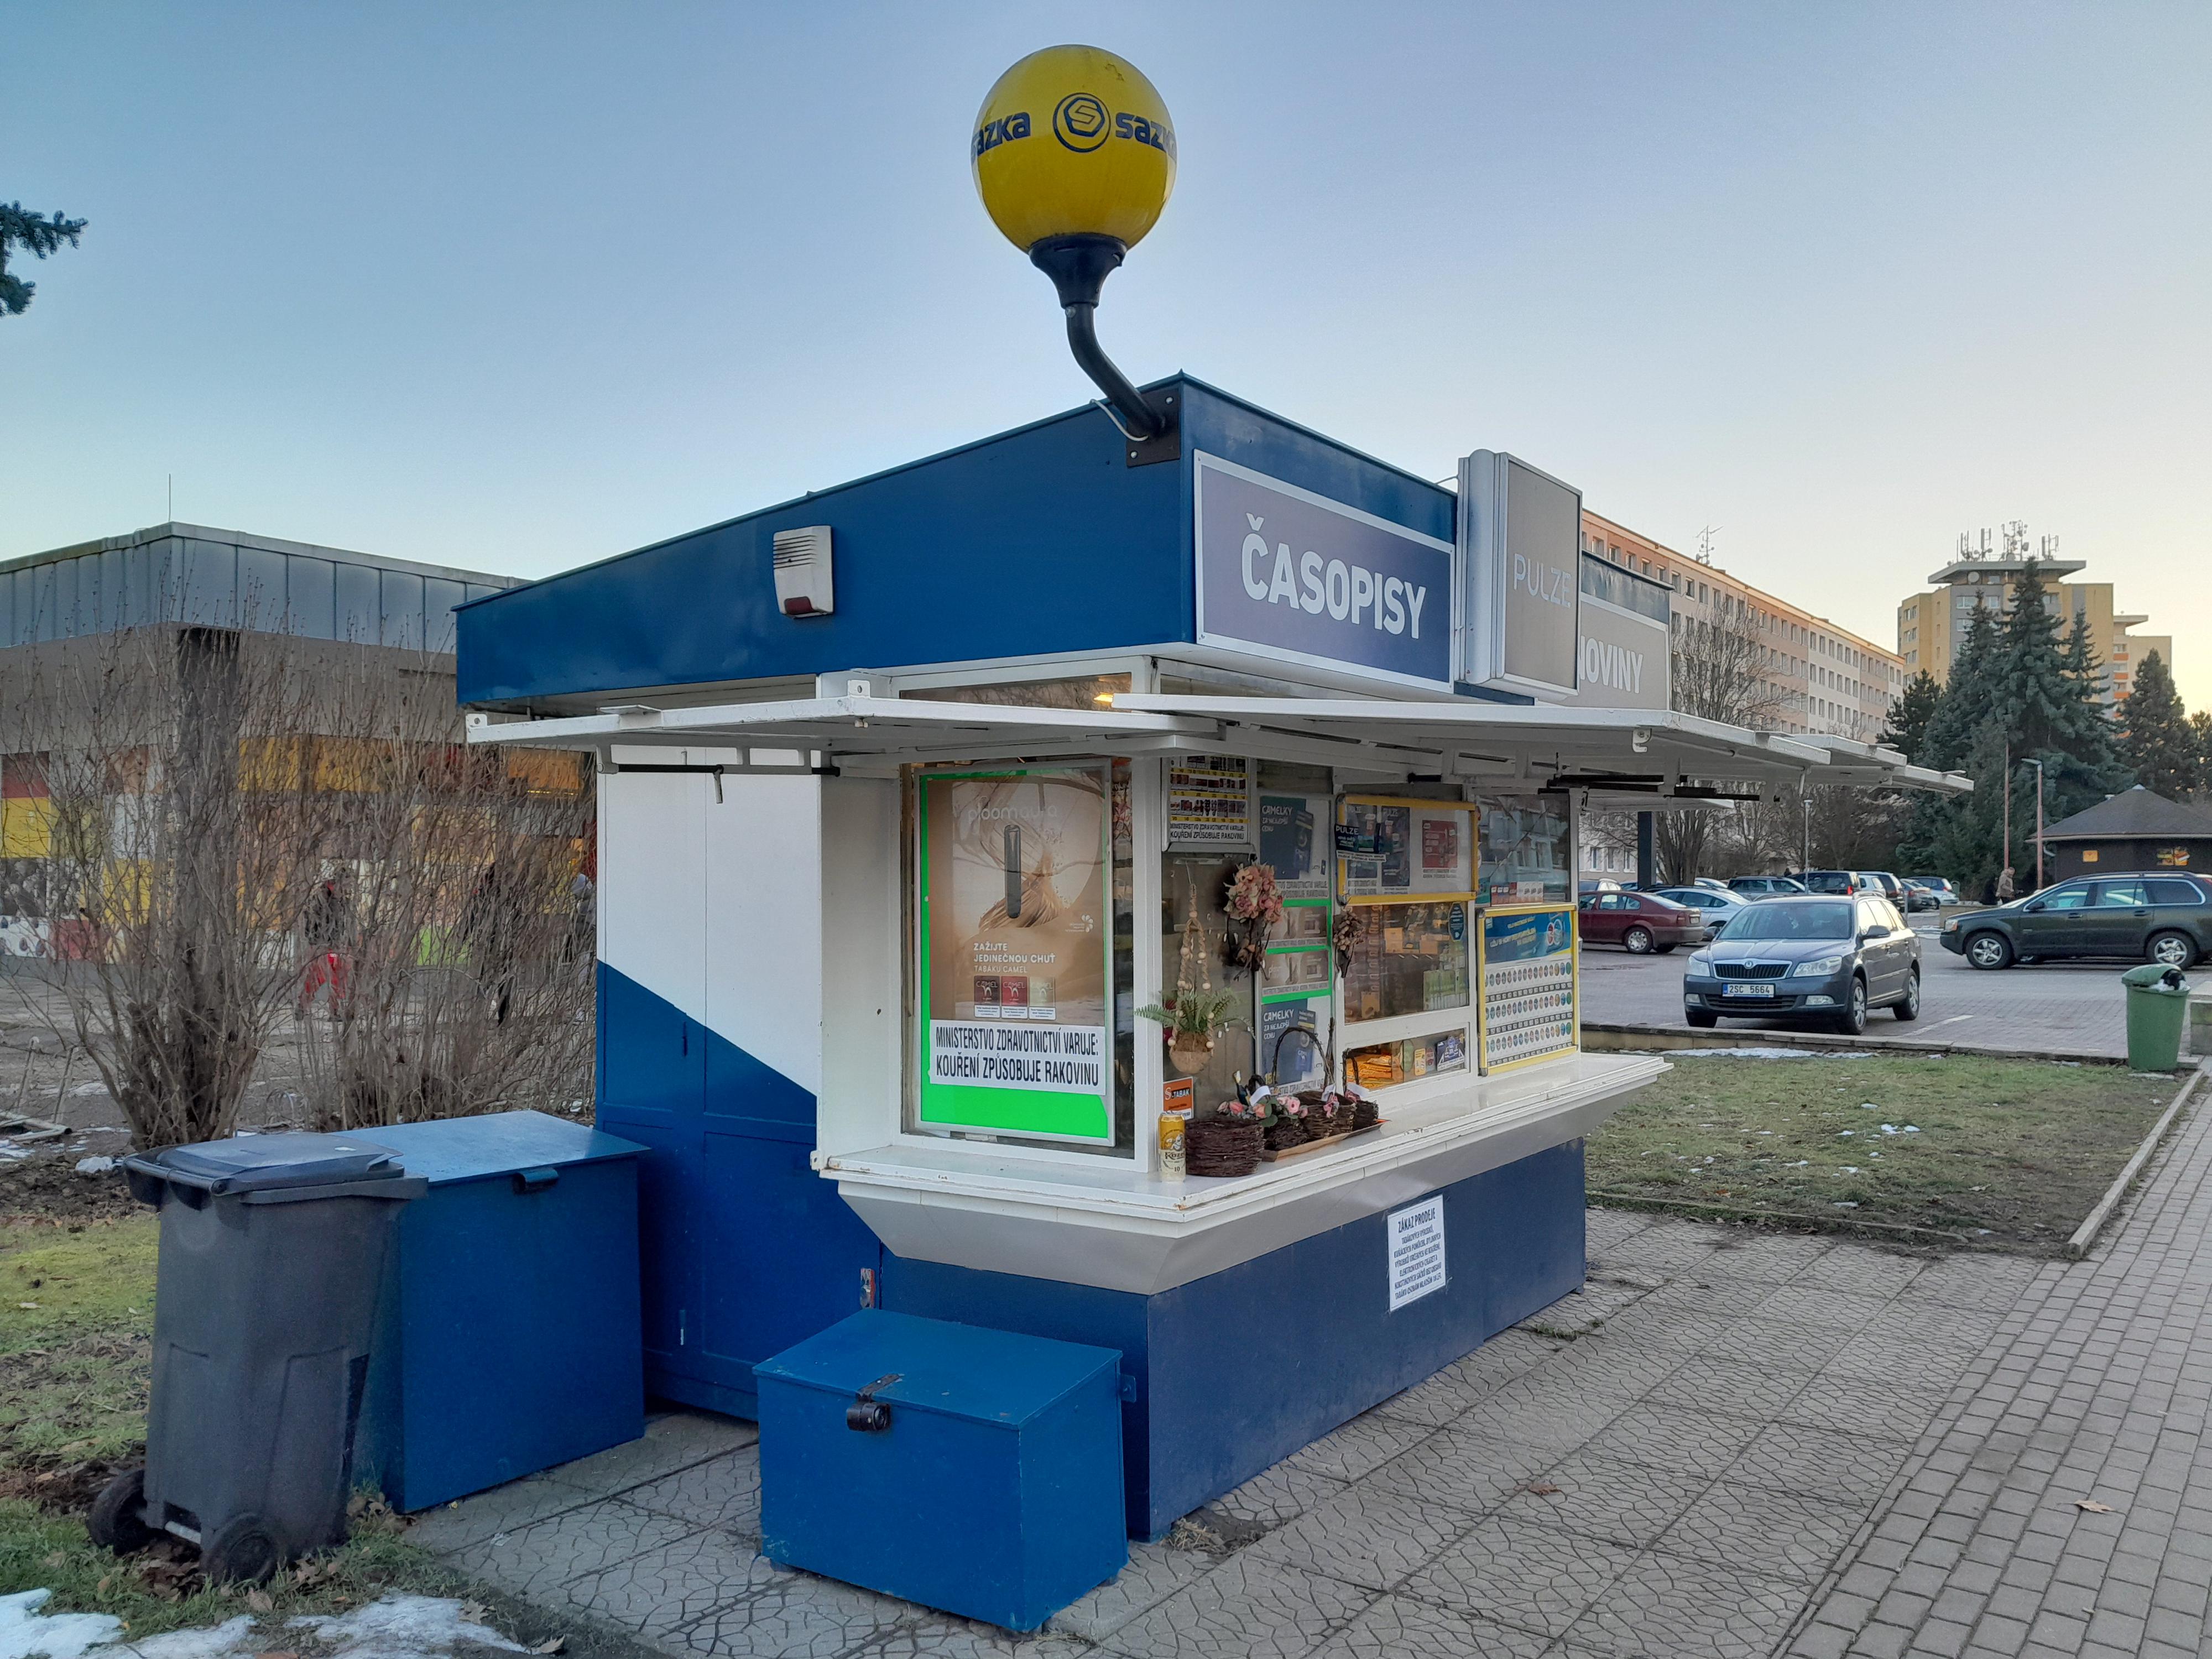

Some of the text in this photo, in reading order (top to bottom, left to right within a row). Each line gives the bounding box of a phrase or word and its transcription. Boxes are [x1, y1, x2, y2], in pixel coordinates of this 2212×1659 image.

[1241, 512, 1426, 640] ČASOPISY
[1514, 553, 1571, 608] PULZE
[1261, 805, 1293, 816] CAMELKY
[1335, 825, 1359, 835] PULZE
[973, 941, 1008, 951] ZAŽIJTE
[973, 953, 1056, 963] JEDINEČNOU CHUŤ
[1750, 985, 1770, 994] 5664
[1263, 1009, 1295, 1022] CAMELKY
[936, 1026, 1099, 1056] MINISTERSTVO ZDRAVOTNICTVÍ VARUJE:
[936, 1051, 1099, 1086] KOUŘENÍ ZPŮSOBUJE RAKOVINU
[1398, 1208, 1436, 1234] ZÁKAZ PRODEJE
